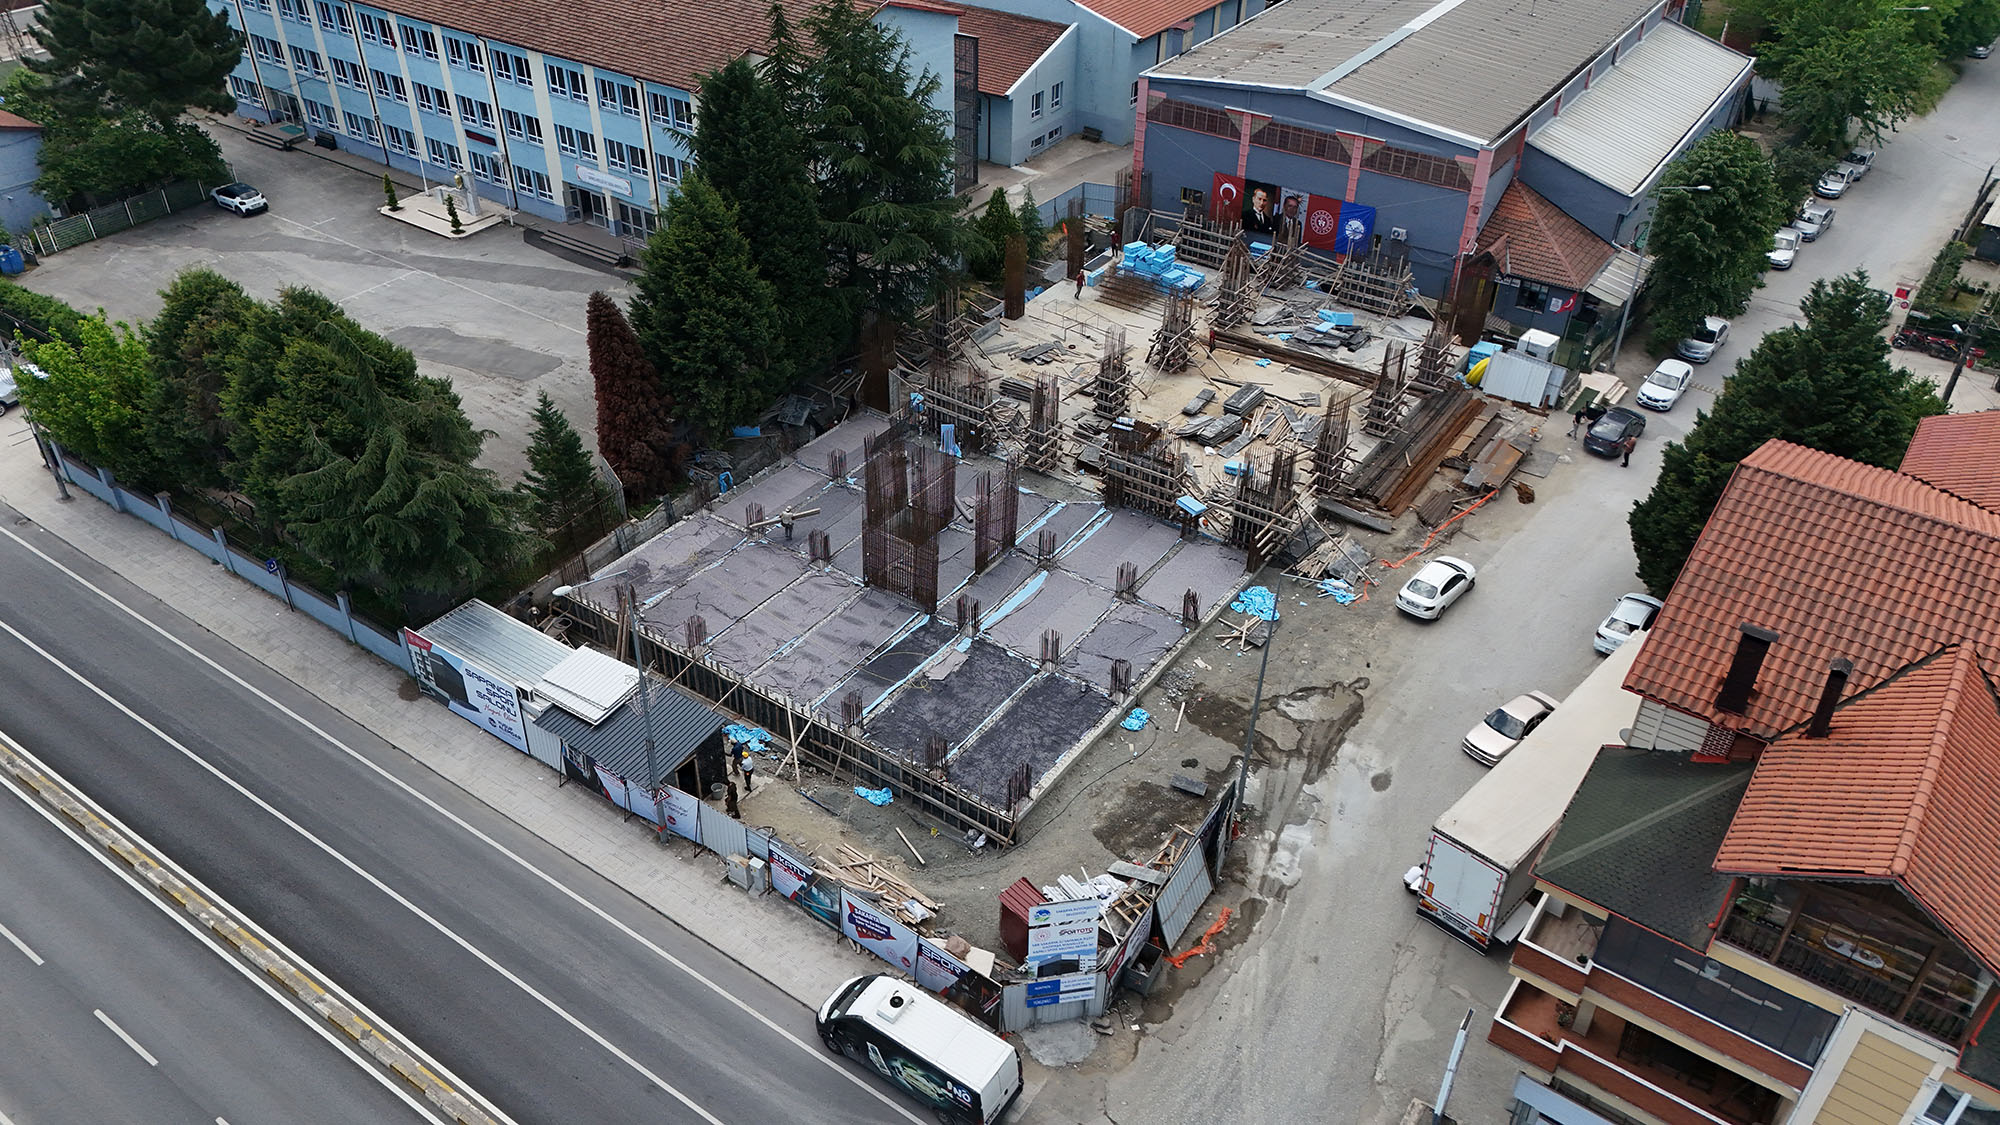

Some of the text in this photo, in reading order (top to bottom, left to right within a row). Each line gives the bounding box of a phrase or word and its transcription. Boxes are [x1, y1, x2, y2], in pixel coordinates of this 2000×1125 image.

[465, 668, 514, 699] SAPANCA
[476, 690, 516, 717] SALONU
[486, 688, 514, 708] SPOR
[922, 946, 961, 975] SPOR
